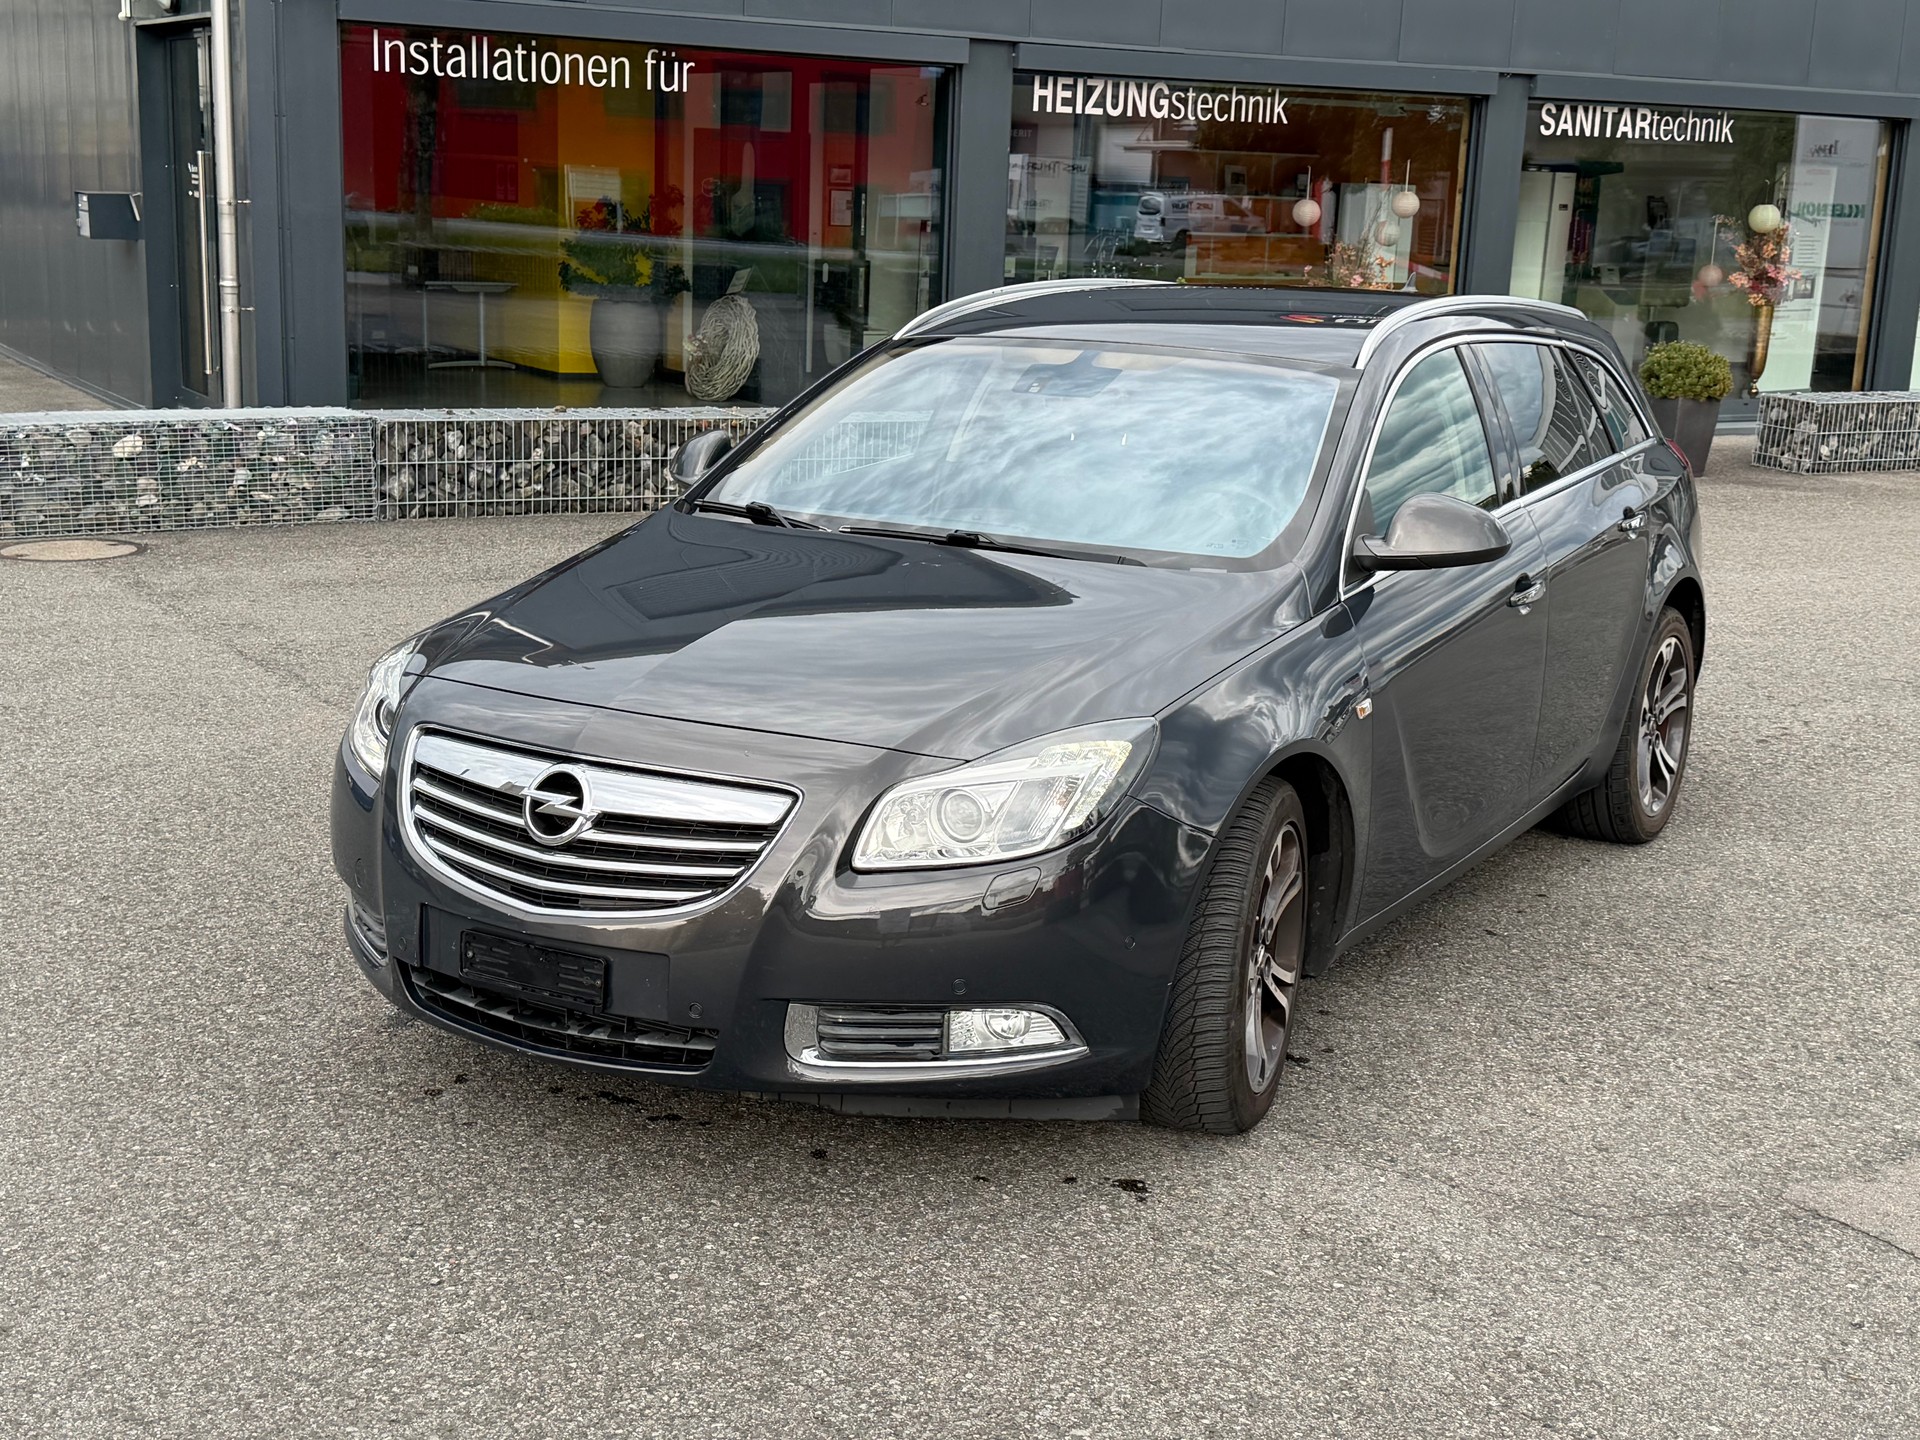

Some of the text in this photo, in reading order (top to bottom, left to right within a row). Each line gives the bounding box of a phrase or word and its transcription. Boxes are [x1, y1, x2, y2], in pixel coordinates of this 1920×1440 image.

[371, 29, 696, 94] Installationen für
[1032, 75, 1289, 125] HEIZUNGstechnik
[1539, 103, 1735, 144] SANITARtechnik
